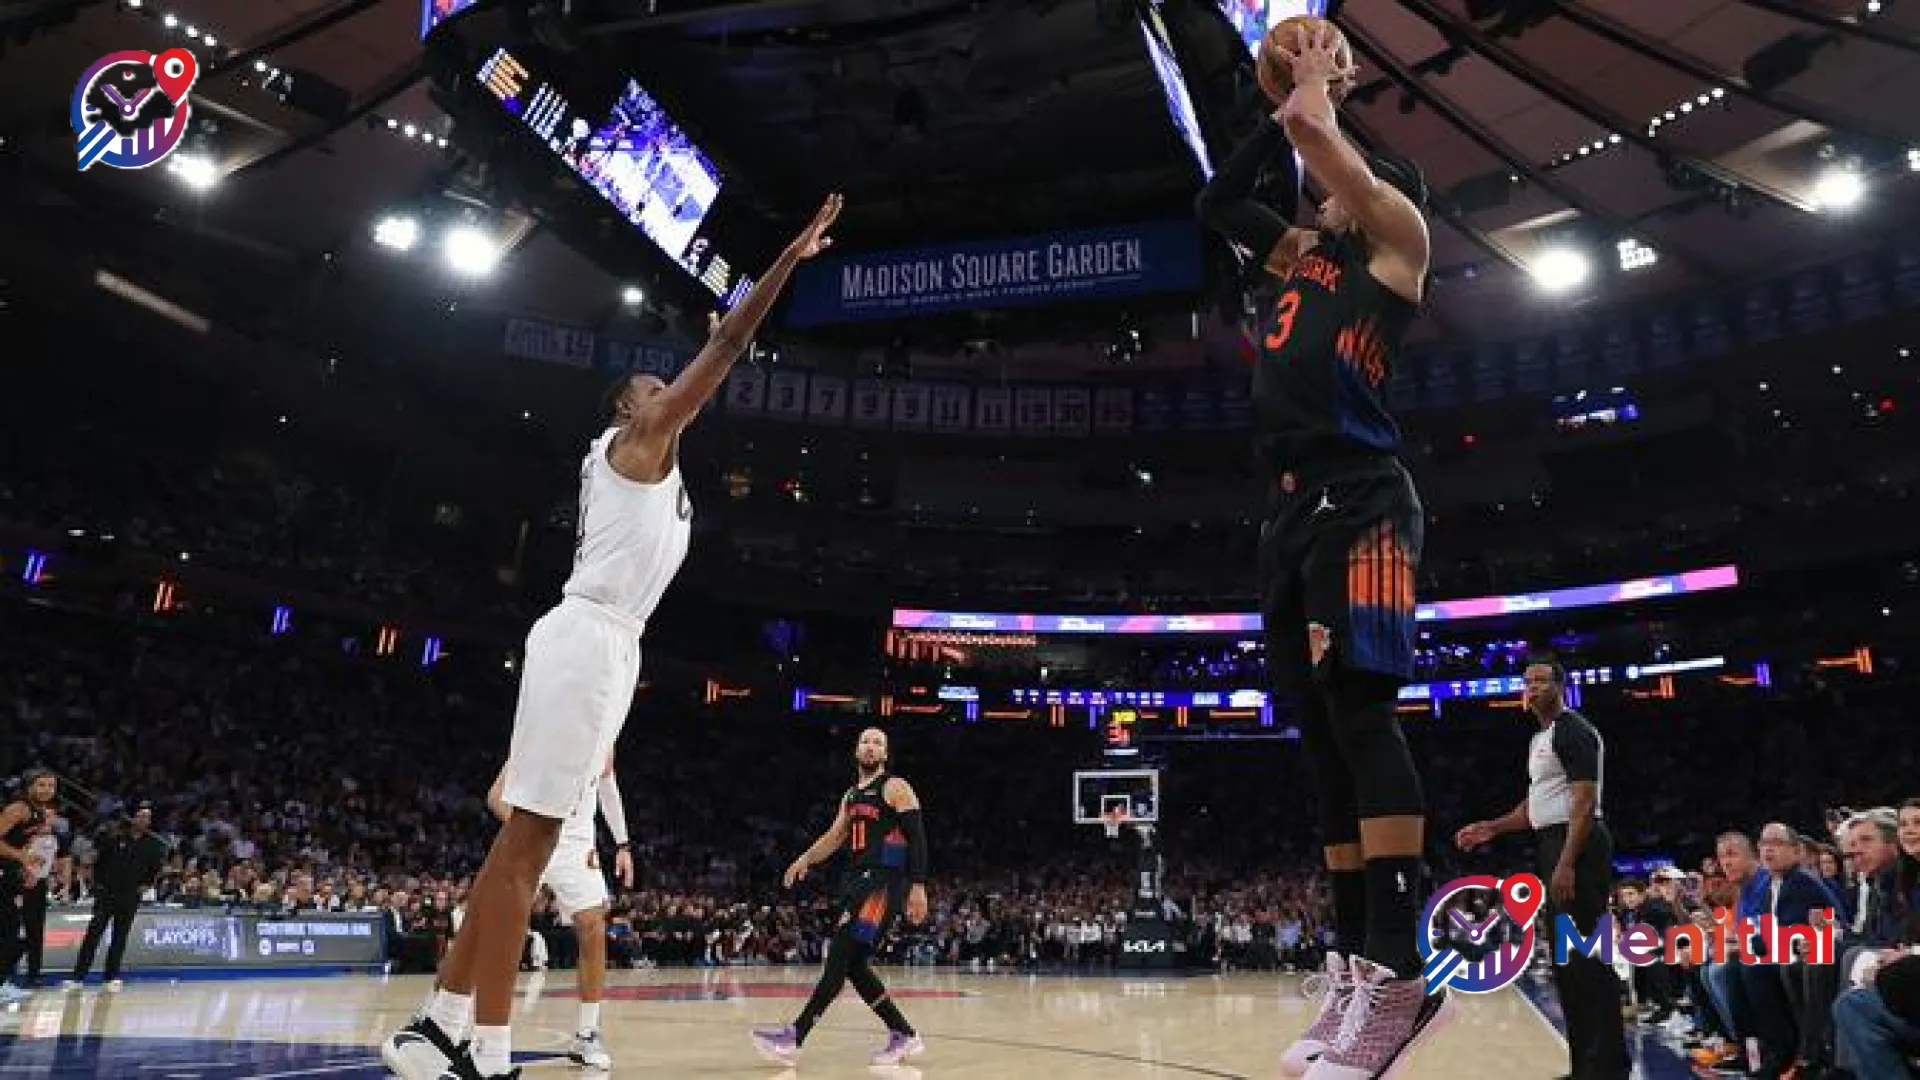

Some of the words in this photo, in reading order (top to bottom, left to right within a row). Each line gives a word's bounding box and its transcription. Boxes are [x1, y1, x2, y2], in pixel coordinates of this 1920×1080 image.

[842, 260, 943, 300] MADISON
[952, 250, 1040, 289] SQUARE
[1047, 238, 1142, 277] GARDEN
[1264, 290, 1299, 349] 3
[144, 928, 217, 947] PLAYOFFS
[1123, 940, 1165, 953] KIA
